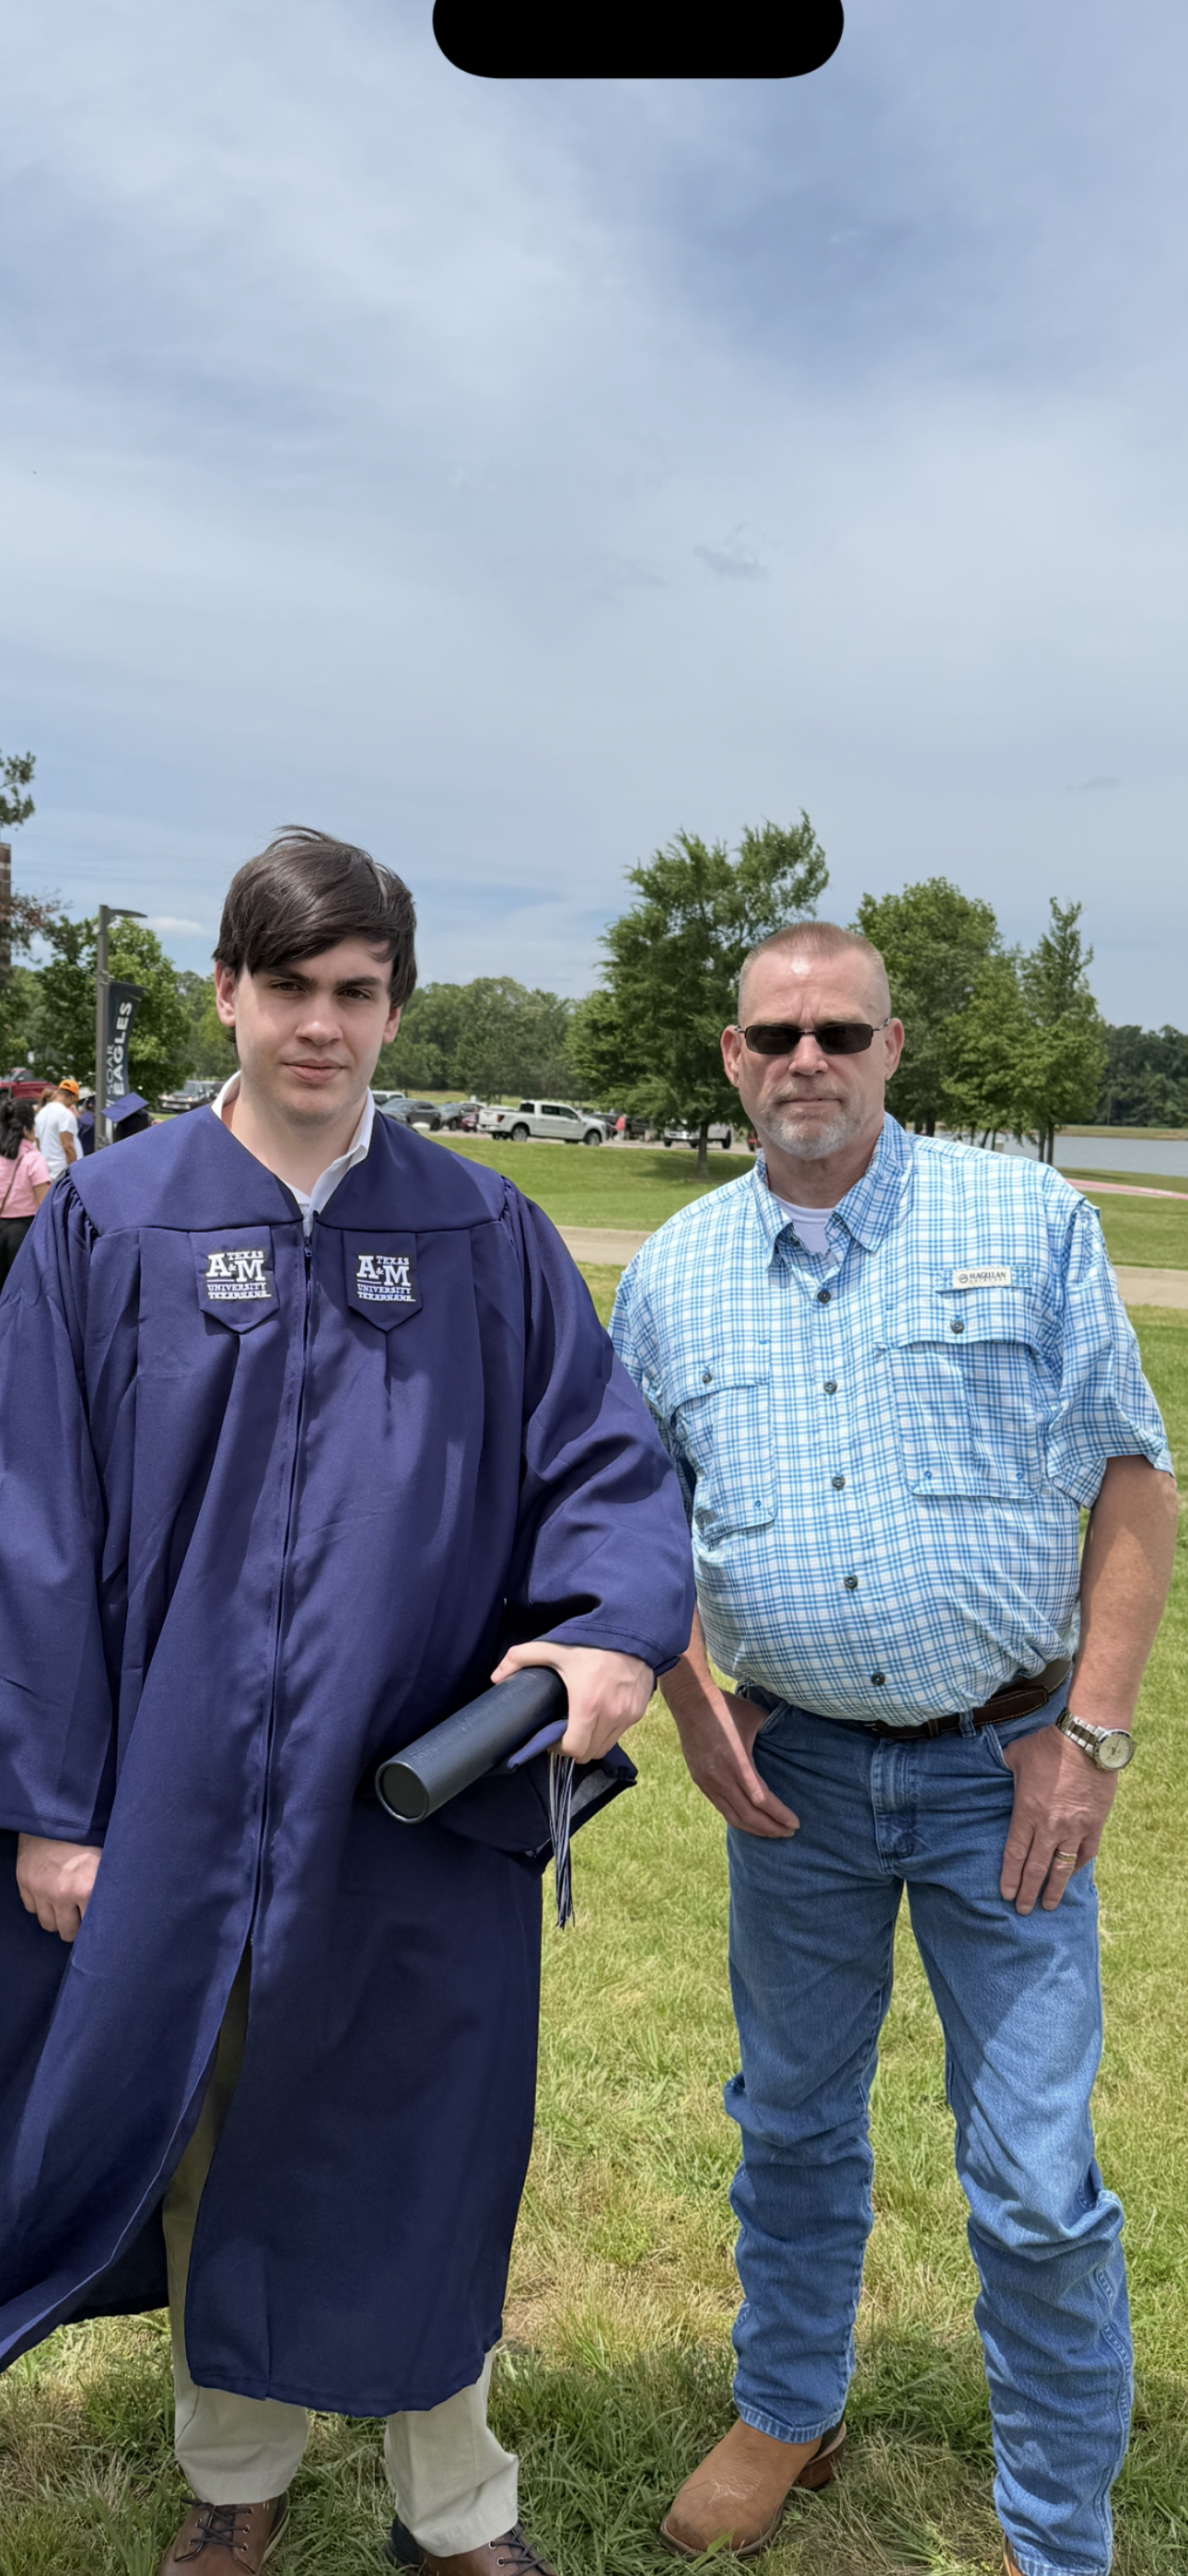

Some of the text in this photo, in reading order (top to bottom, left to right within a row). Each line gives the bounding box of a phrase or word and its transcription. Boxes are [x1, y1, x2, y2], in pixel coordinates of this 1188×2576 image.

[112, 1001, 133, 1095] EAGLES
[106, 1044, 114, 1095] SOAR
[227, 1251, 263, 1260] TEXAS
[376, 1256, 410, 1265] TEXAS
[205, 1253, 266, 1282] A&M
[356, 1255, 411, 1287] A&M
[206, 1282, 267, 1292] UNIVERSITY
[356, 1283, 412, 1294] UNIVERSITY
